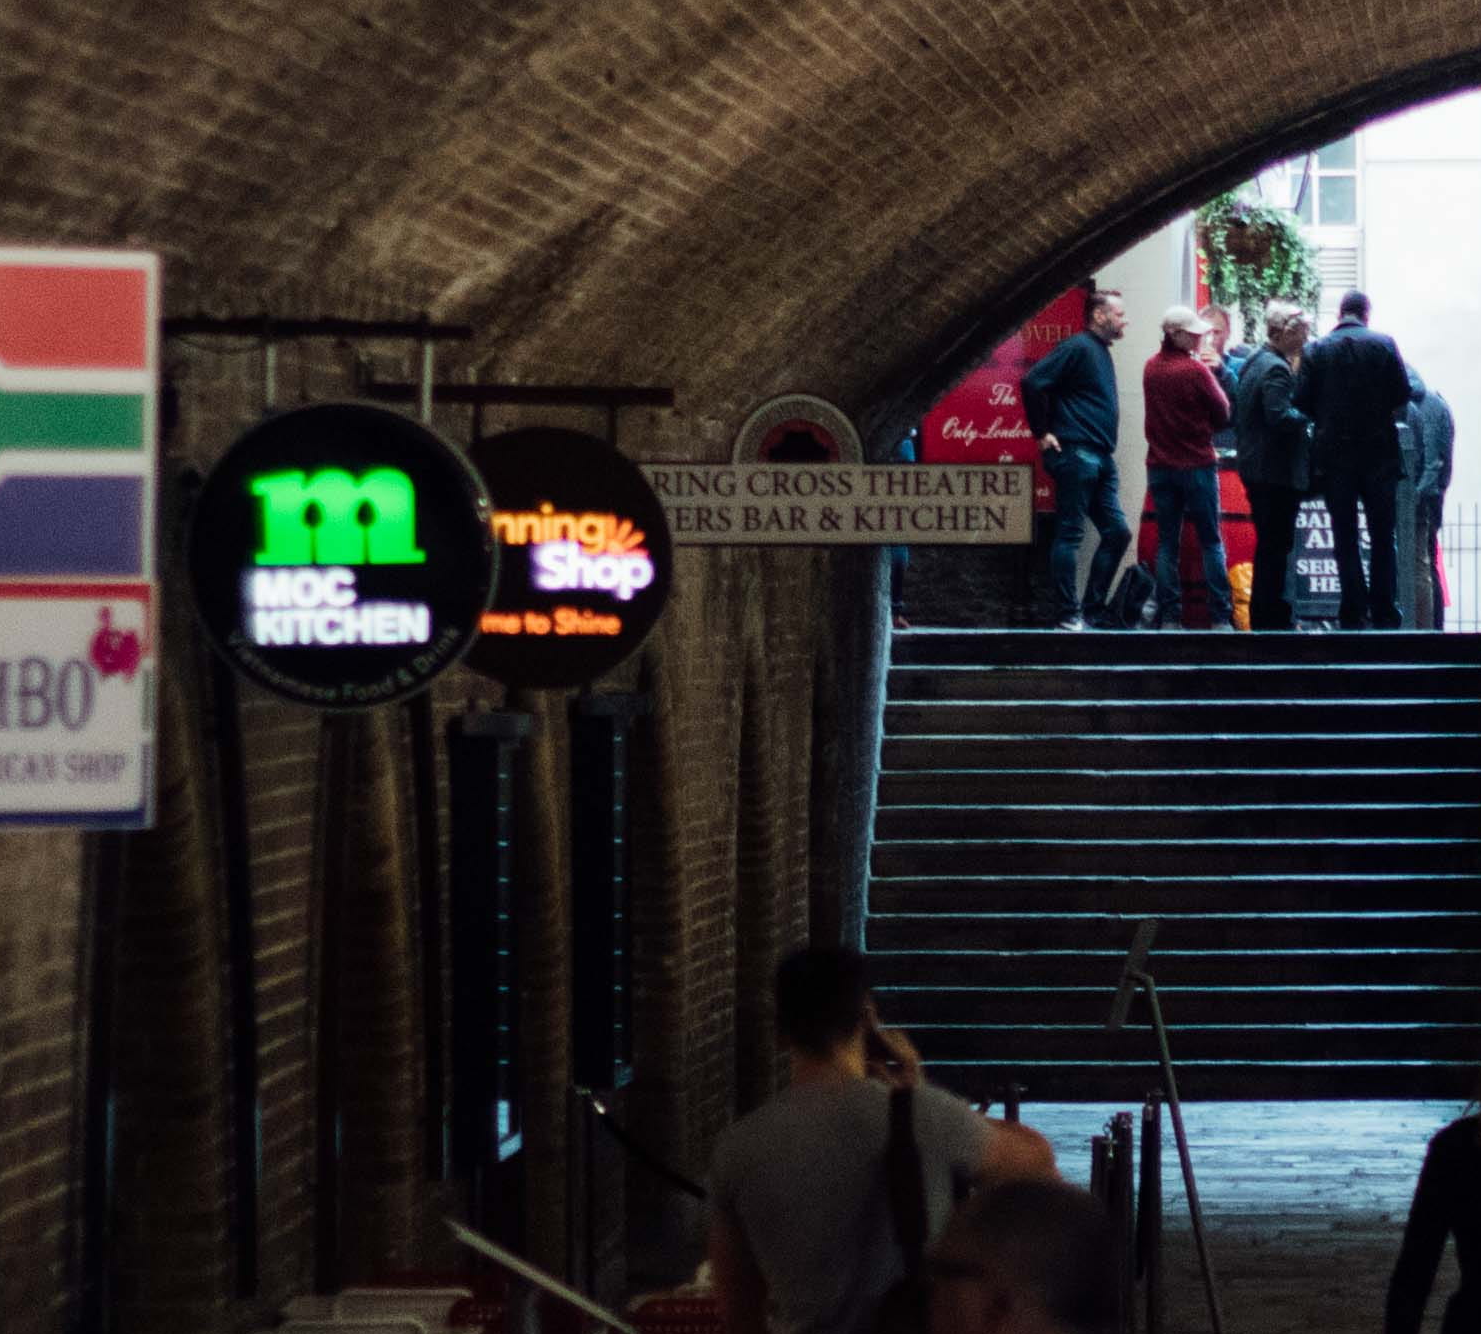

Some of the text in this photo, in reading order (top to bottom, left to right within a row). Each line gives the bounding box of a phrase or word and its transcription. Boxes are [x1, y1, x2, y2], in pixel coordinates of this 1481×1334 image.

[988, 382, 1018, 407] The
[942, 416, 979, 447] Only
[654, 470, 737, 497] RING
[747, 470, 854, 497] CROSS
[863, 469, 1022, 497] THEATRE
[490, 500, 607, 554] nning
[668, 505, 1009, 533] ERS BAR & KITCHEN
[532, 537, 655, 601] Shop
[250, 565, 357, 609] MOC
[250, 601, 432, 647] KITCHEN
[480, 605, 623, 636] me to Shine
[64, 752, 130, 785] SHOP
